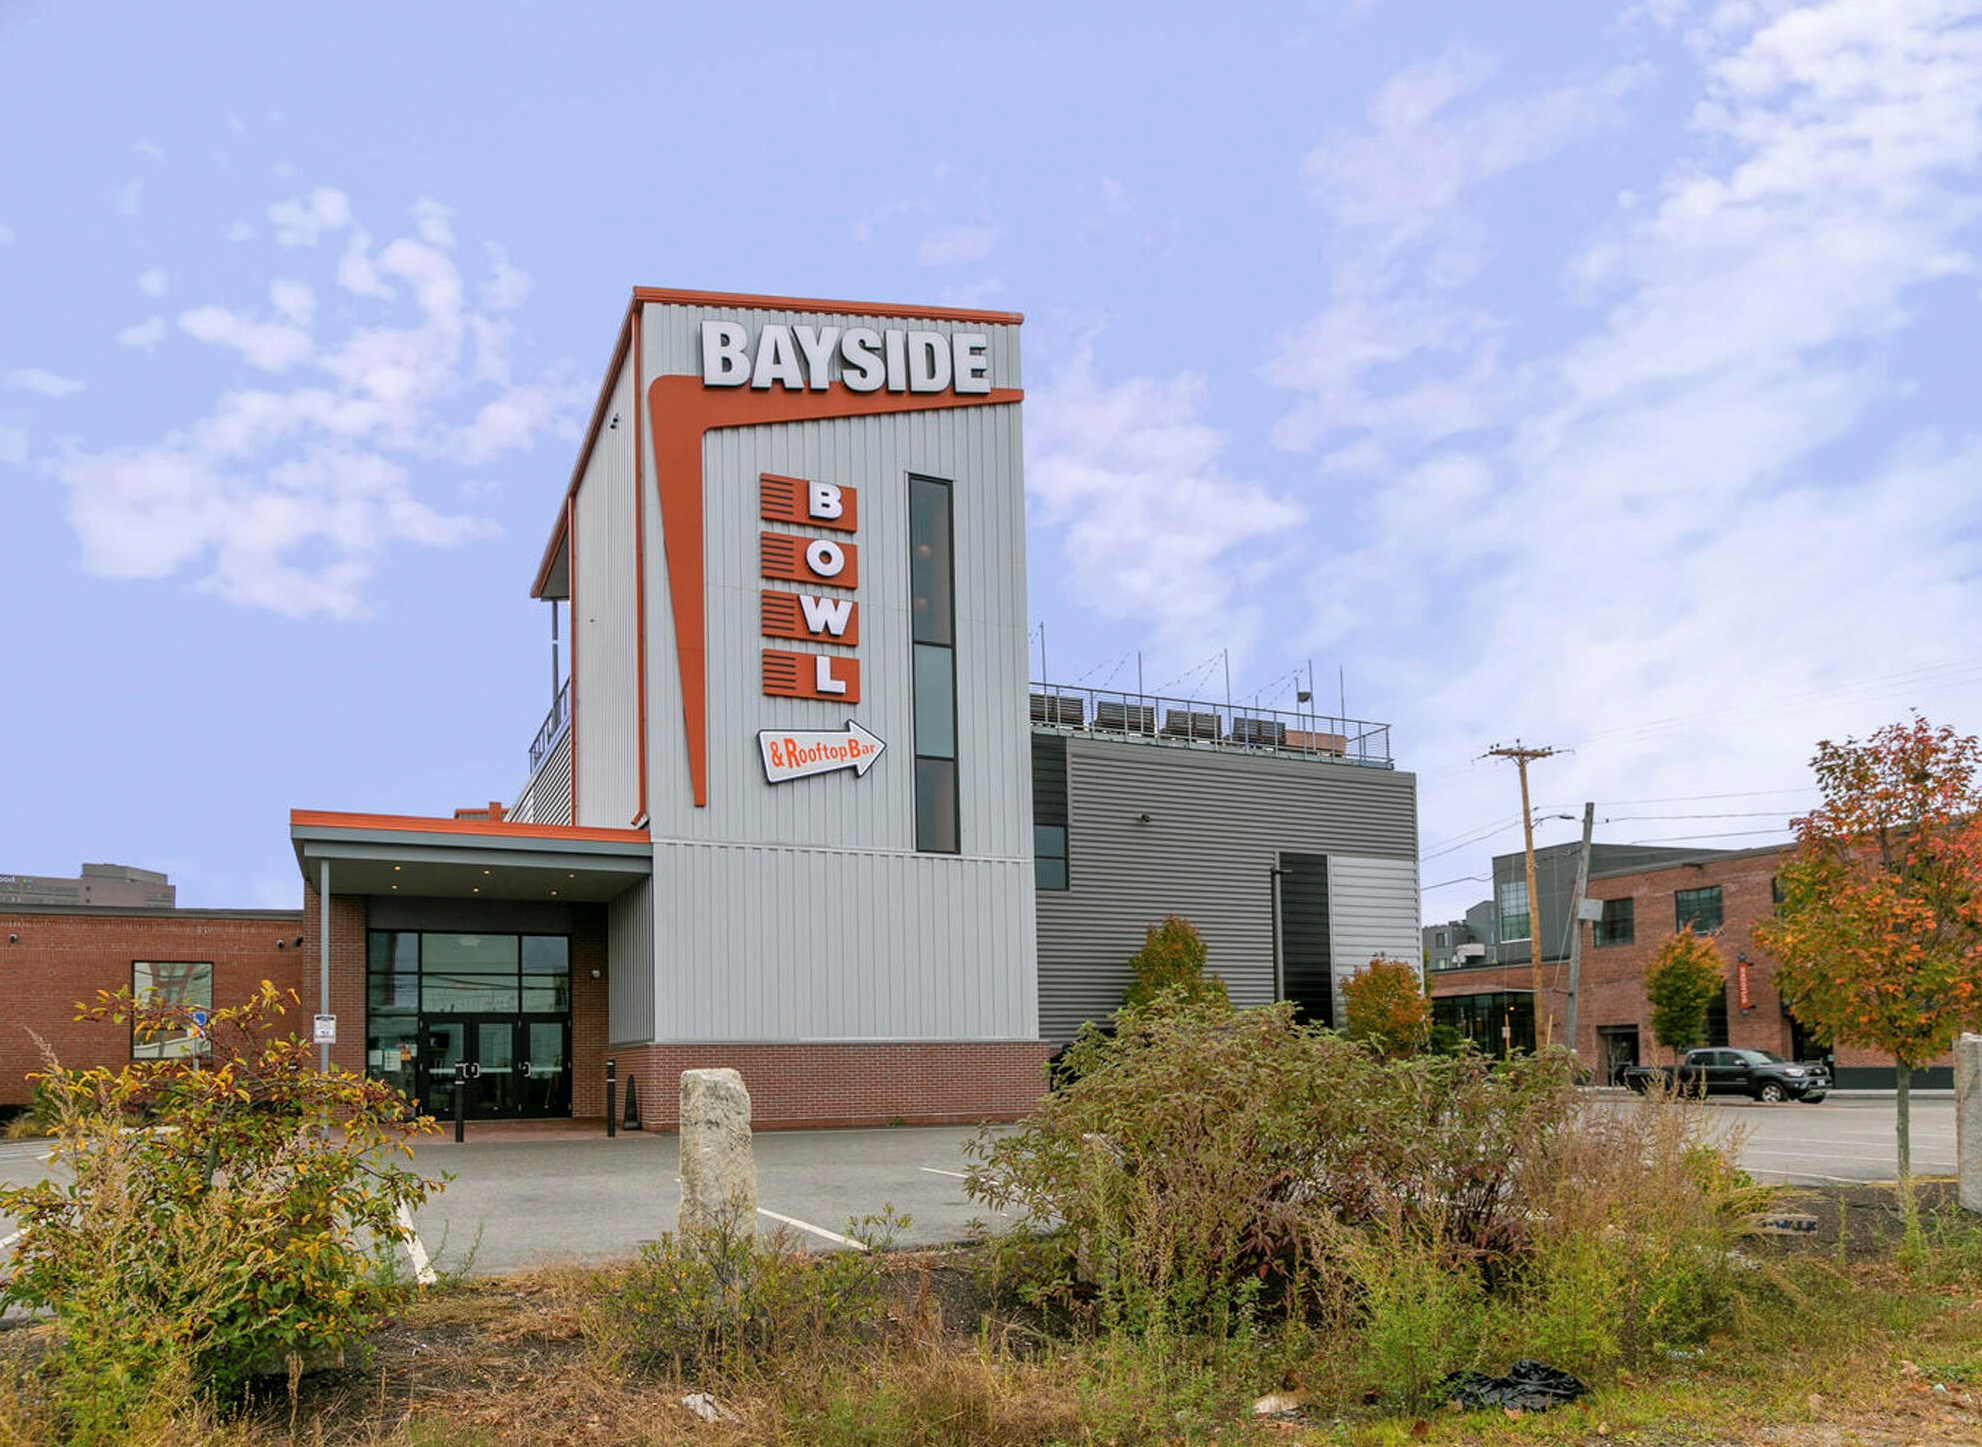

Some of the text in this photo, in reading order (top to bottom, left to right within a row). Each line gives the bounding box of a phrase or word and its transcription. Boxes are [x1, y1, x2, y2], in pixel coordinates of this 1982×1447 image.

[701, 319, 991, 394] BAYSIDE
[799, 480, 853, 694] BOWL
[769, 740, 785, 769] &
